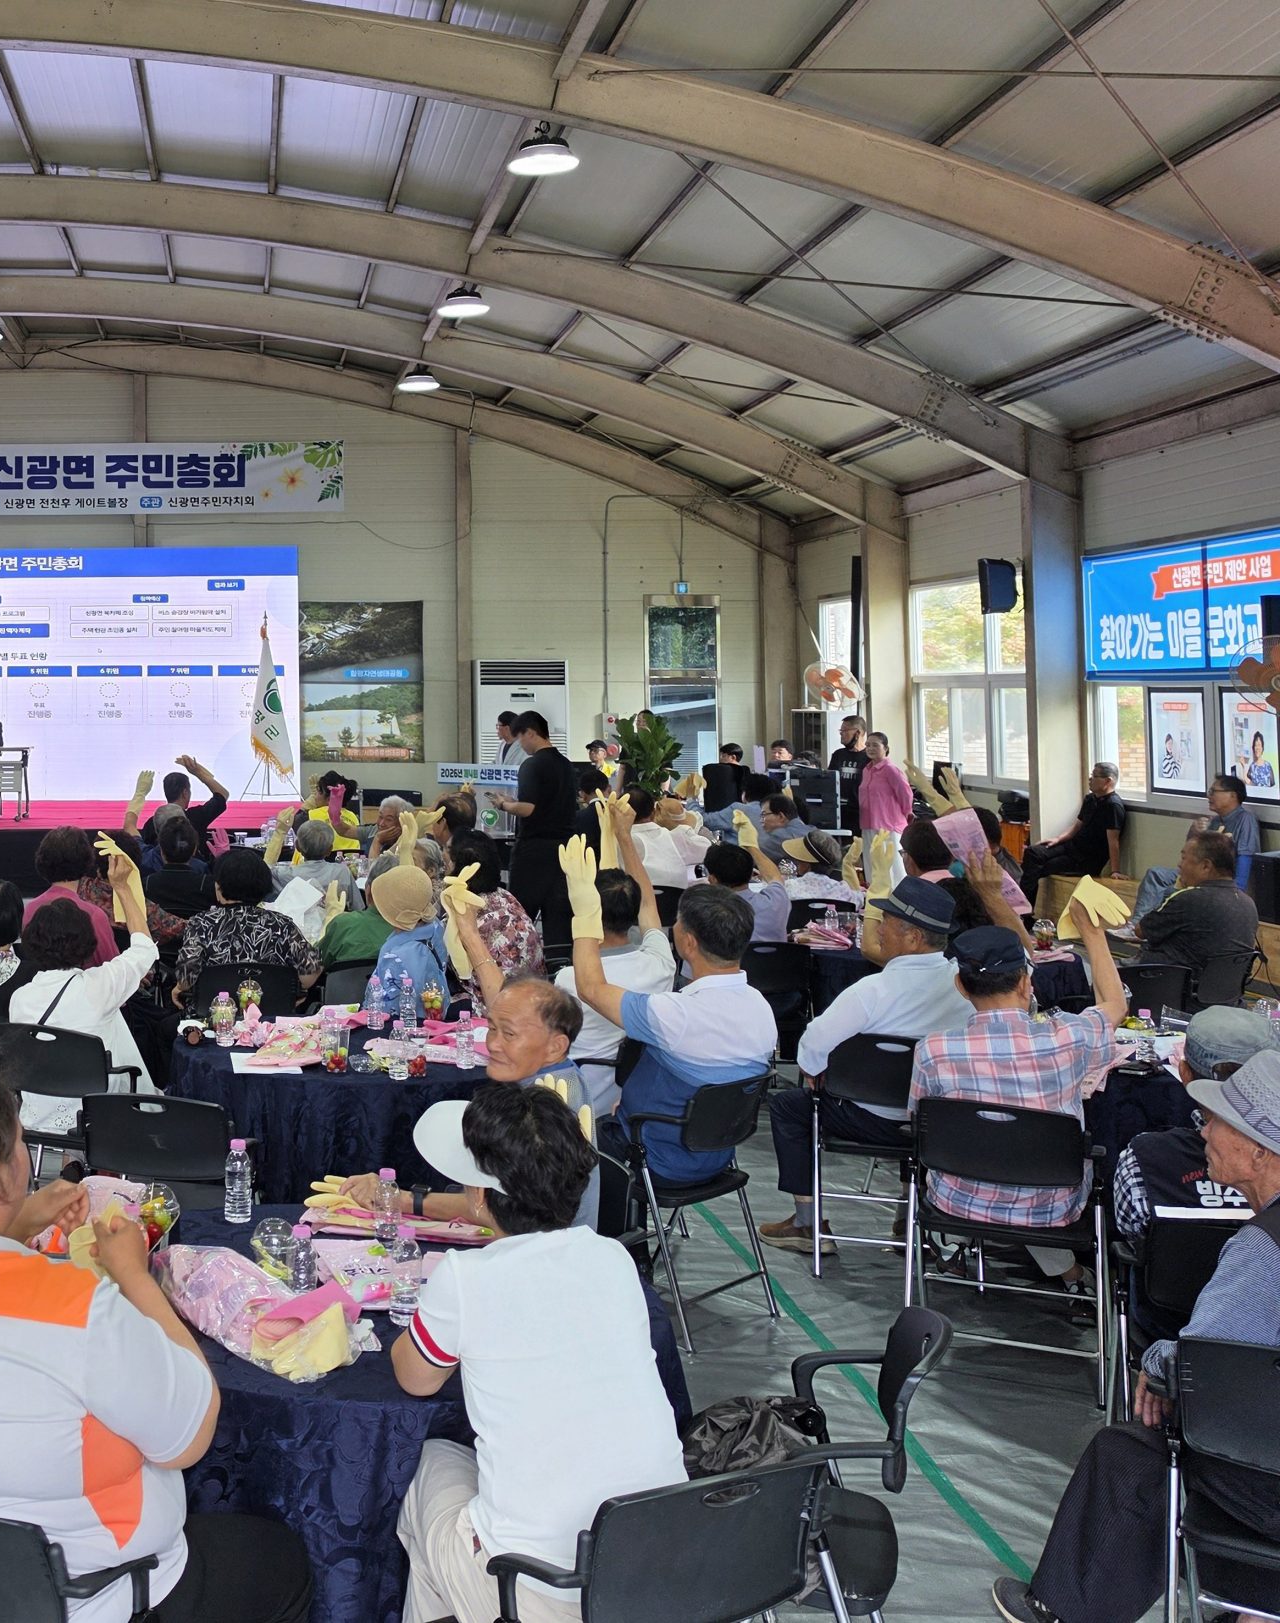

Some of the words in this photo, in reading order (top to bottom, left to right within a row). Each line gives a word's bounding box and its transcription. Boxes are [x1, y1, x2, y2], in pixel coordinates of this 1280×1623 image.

[105, 453, 246, 489] 주민총회
[4, 498, 35, 509] 신광면
[39, 498, 71, 508] 전천후
[75, 498, 128, 508] 게이트볼장
[141, 497, 161, 507] 주관
[167, 496, 255, 507] 신광면주민자치회
[21, 556, 83, 571] 주민총회
[1172, 565, 1201, 588] 신광면
[1203, 562, 1223, 584] 주민
[1225, 559, 1247, 581] 제안
[1249, 555, 1272, 578] 사업
[1100, 612, 1163, 661] 찾아가는
[1166, 608, 1202, 659] 마을
[11, 652, 28, 661] 투표
[27, 710, 52, 718] 진행중
[97, 710, 122, 718] 진행중
[168, 710, 193, 718] 진행중
[440, 768, 463, 778] 2026년
[480, 768, 502, 780] 신광면
[1181, 1168, 1205, 1184] new
